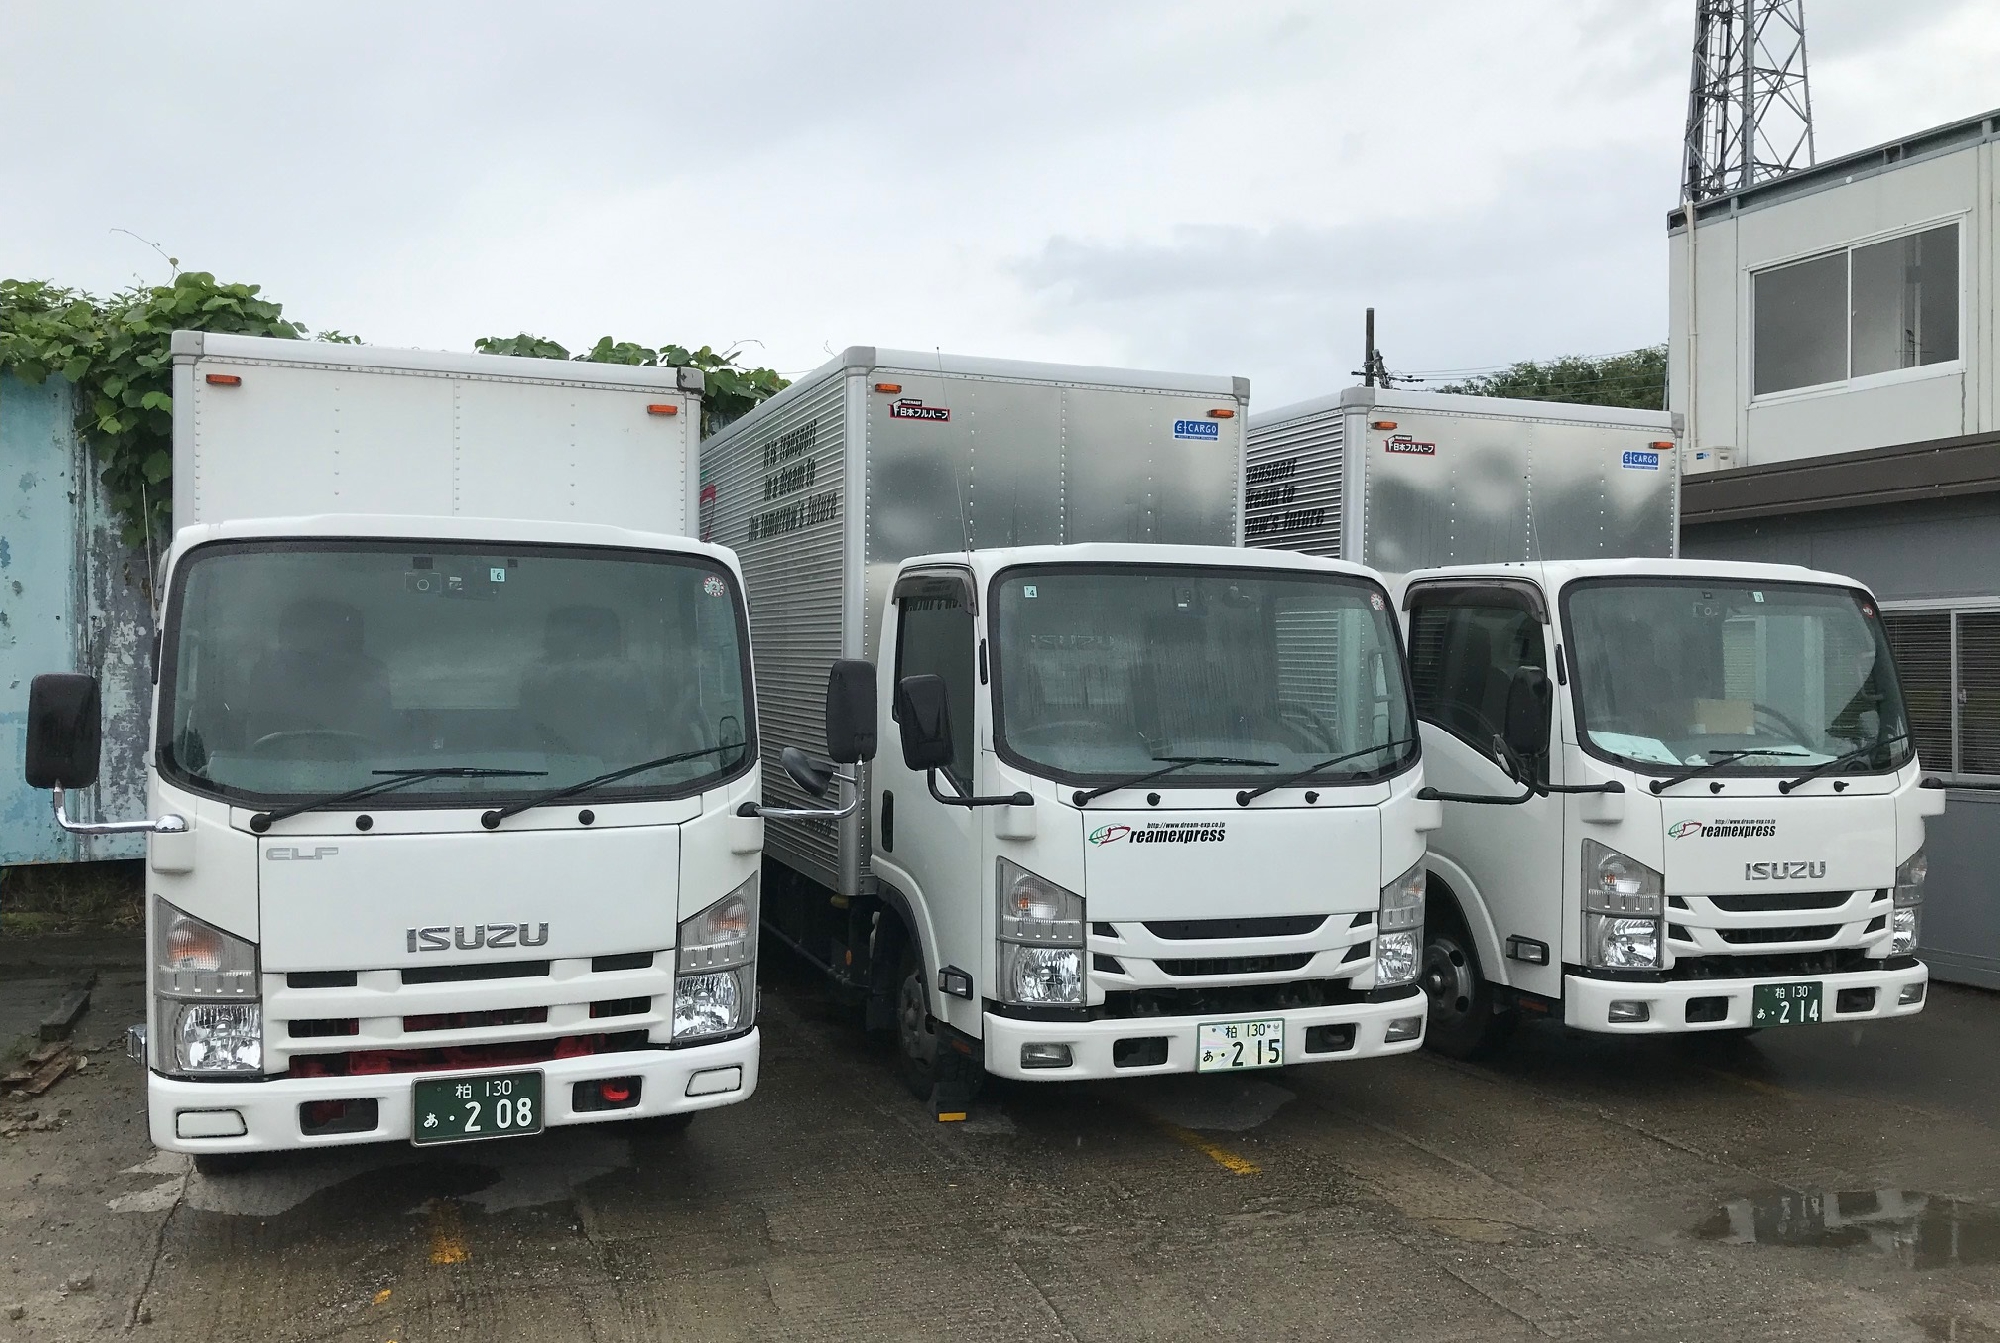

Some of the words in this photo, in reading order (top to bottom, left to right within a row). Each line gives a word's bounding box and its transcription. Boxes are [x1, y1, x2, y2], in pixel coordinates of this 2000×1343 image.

[900, 407, 949, 419] 日本フルハーフ
[1177, 423, 1217, 434] E-CARGO
[1393, 443, 1434, 453] 日本フルハーフ
[1624, 453, 1658, 464] E-CARGO
[1745, 860, 1826, 881] ISUZU
[406, 921, 549, 953] ISUZU
[1776, 987, 1785, 999] 柏
[1792, 985, 1808, 998] 130
[1757, 1008, 1766, 1020] あ
[1225, 1026, 1238, 1039] 柏
[1247, 1023, 1266, 1037] 130
[1203, 1050, 1214, 1063] あ
[455, 1083, 472, 1099] 柏
[485, 1079, 512, 1097] 130
[423, 1112, 439, 1128] あ
